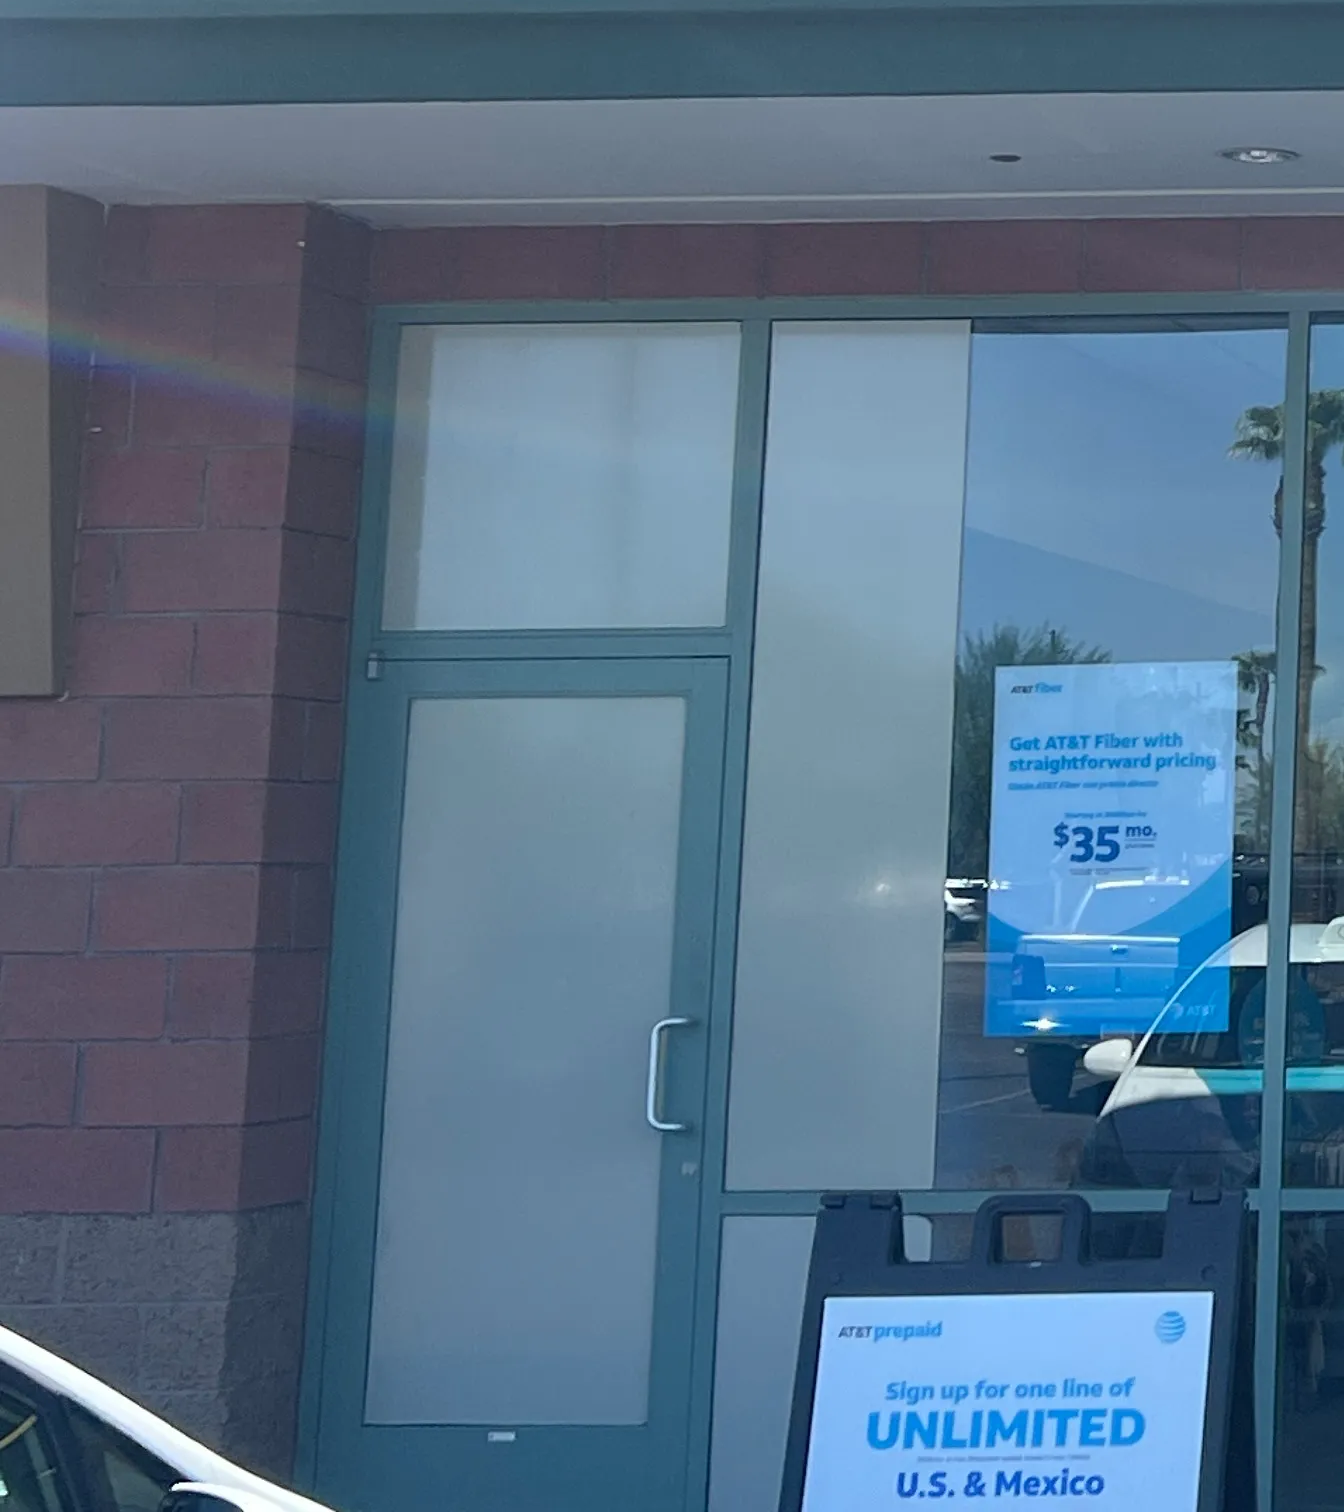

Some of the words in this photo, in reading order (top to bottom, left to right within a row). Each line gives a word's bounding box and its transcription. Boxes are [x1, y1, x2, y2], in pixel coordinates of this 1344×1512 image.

[1035, 681, 1064, 694] Fiber
[1010, 736, 1041, 752] Get
[1044, 735, 1088, 751] AT&T
[1094, 733, 1139, 750] Fiber
[1143, 732, 1183, 749] with
[1008, 754, 1152, 775] straightforward
[1155, 752, 1217, 773] pricing
[1053, 821, 1121, 863] $35
[838, 1325, 873, 1339] AT&T
[873, 1321, 943, 1343] prepaid
[885, 1380, 935, 1406] Sign
[940, 1382, 970, 1405] up
[974, 1378, 1010, 1400] for
[1014, 1381, 1057, 1399] one
[1062, 1378, 1104, 1398] line
[1108, 1375, 1137, 1397] of
[866, 1407, 1148, 1451] UNLIMITED
[896, 1470, 956, 1499] U.S.
[963, 1470, 986, 1498] &
[994, 1467, 1106, 1498] Mexico
